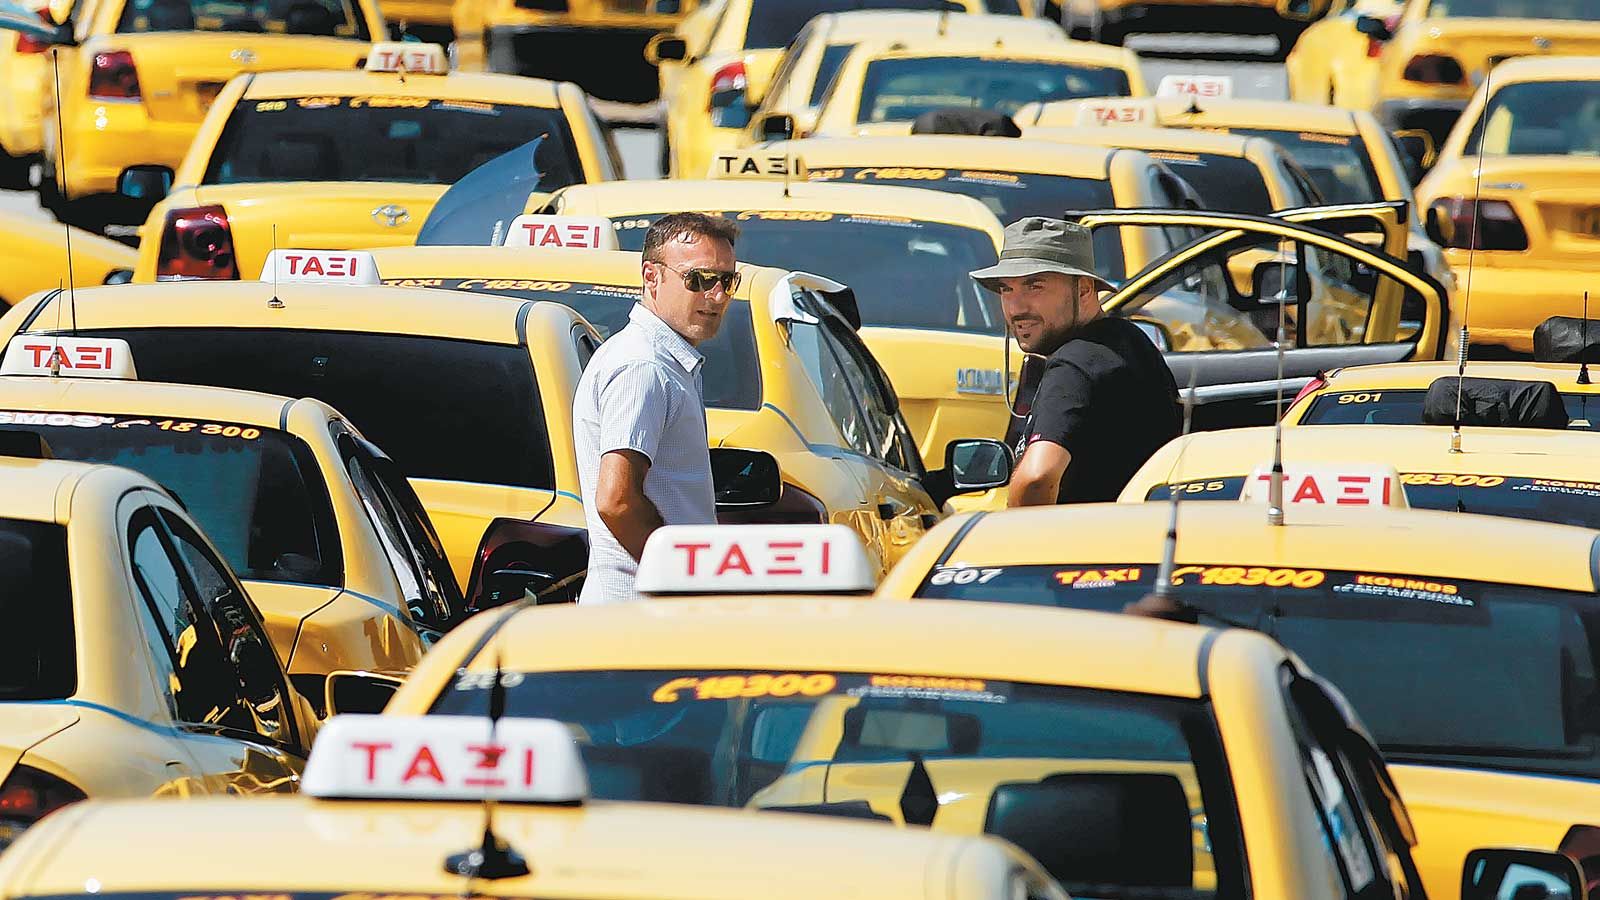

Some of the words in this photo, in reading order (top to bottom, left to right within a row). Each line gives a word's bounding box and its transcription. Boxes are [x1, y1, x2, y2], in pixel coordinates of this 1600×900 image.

[1173, 81, 1224, 97] ΤΑΞΙ
[1092, 107, 1145, 122] ΤΑΞΙ
[718, 155, 801, 175] ΤΑΞΙ
[522, 223, 600, 249] ΤΑΞΙ
[285, 255, 358, 277] ΤΑΞΙ
[484, 280, 572, 293] 18300
[24, 344, 113, 370] ΤΑΞΙ
[1337, 392, 1383, 404] 901
[156, 419, 197, 432] 18
[200, 423, 261, 440] 300
[1168, 480, 1225, 495] 755
[1257, 474, 1392, 506] ΤΑΞΙ
[673, 541, 831, 577] ΤΑΞΙ
[931, 568, 1003, 586] 607
[1055, 567, 1142, 585] TAXI
[1200, 567, 1326, 589] 18300
[1356, 574, 1459, 595] KOSMOS
[695, 673, 837, 700] 18300
[350, 742, 535, 787] ΤΑΞΙ
